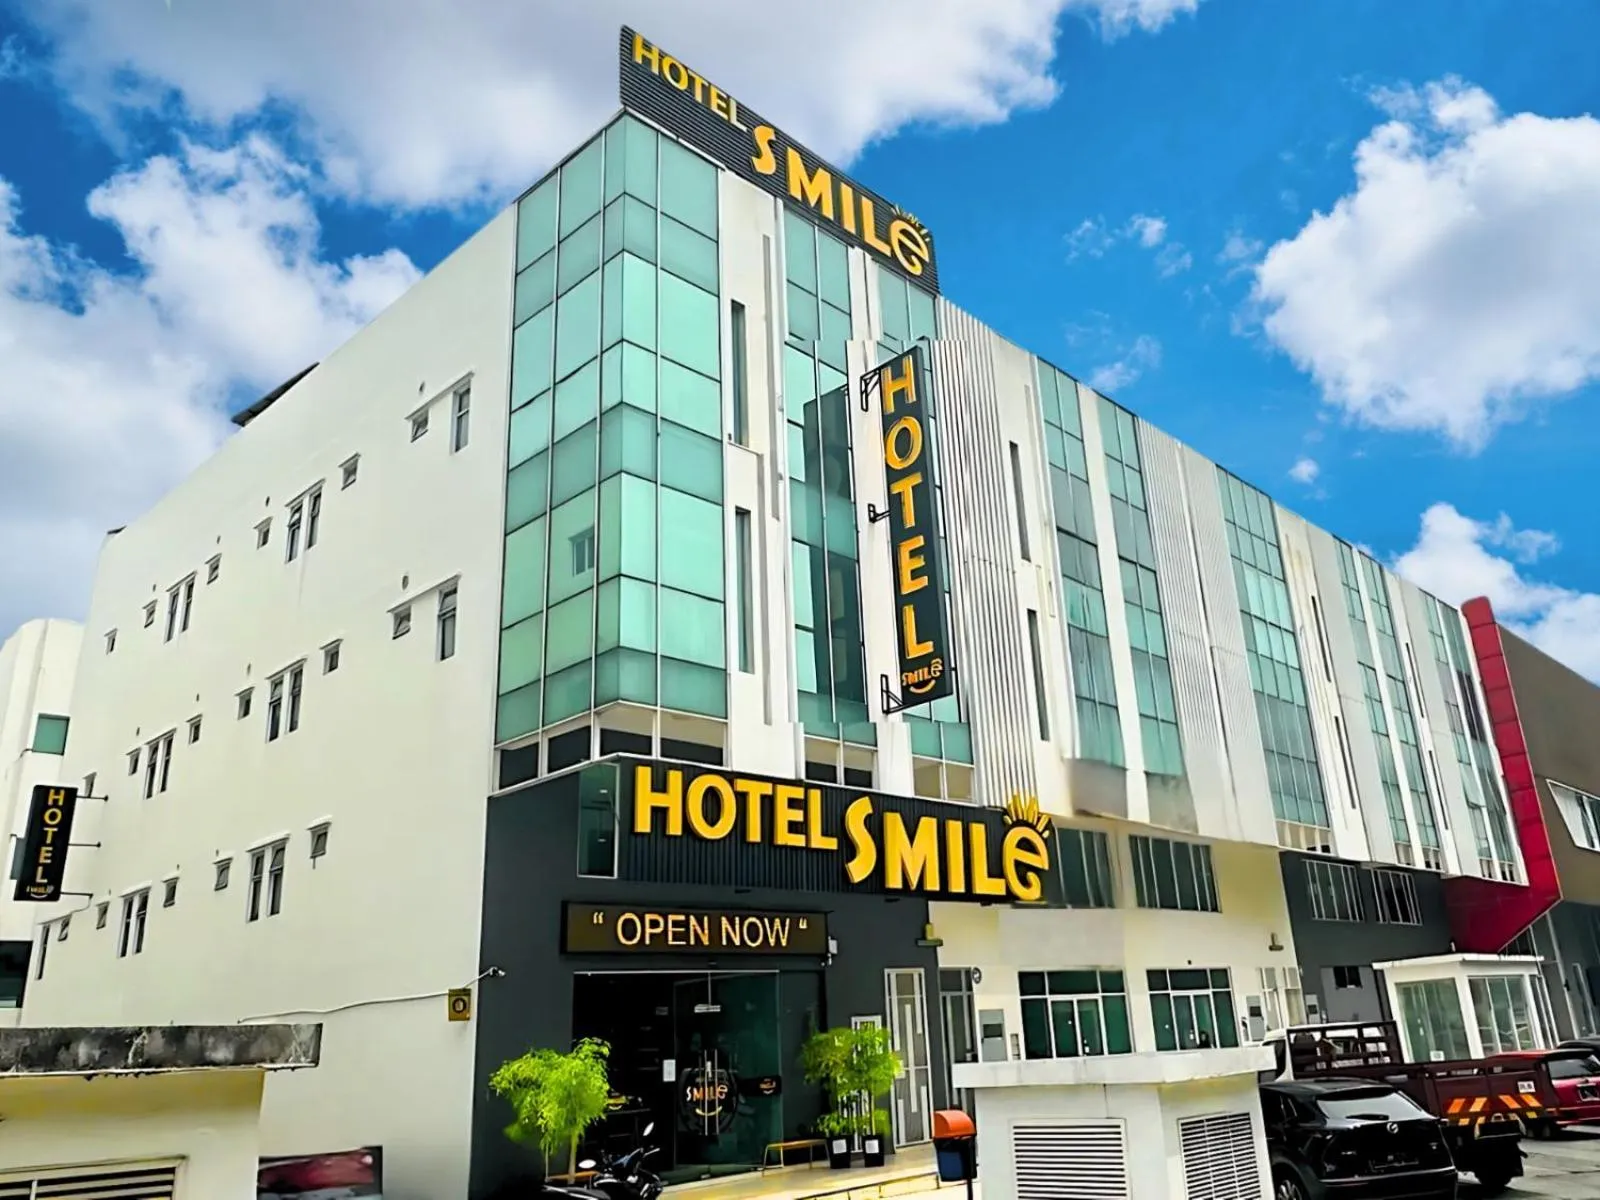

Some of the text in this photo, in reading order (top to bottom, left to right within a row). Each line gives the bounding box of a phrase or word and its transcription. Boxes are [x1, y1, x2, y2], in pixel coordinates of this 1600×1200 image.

[632, 33, 748, 133] HOTEL
[881, 353, 934, 660] HOTEL
[35, 788, 65, 884] HOTEL
[633, 764, 838, 851] HOTEL
[616, 911, 710, 946] OPEN
[721, 915, 790, 947] NOW
